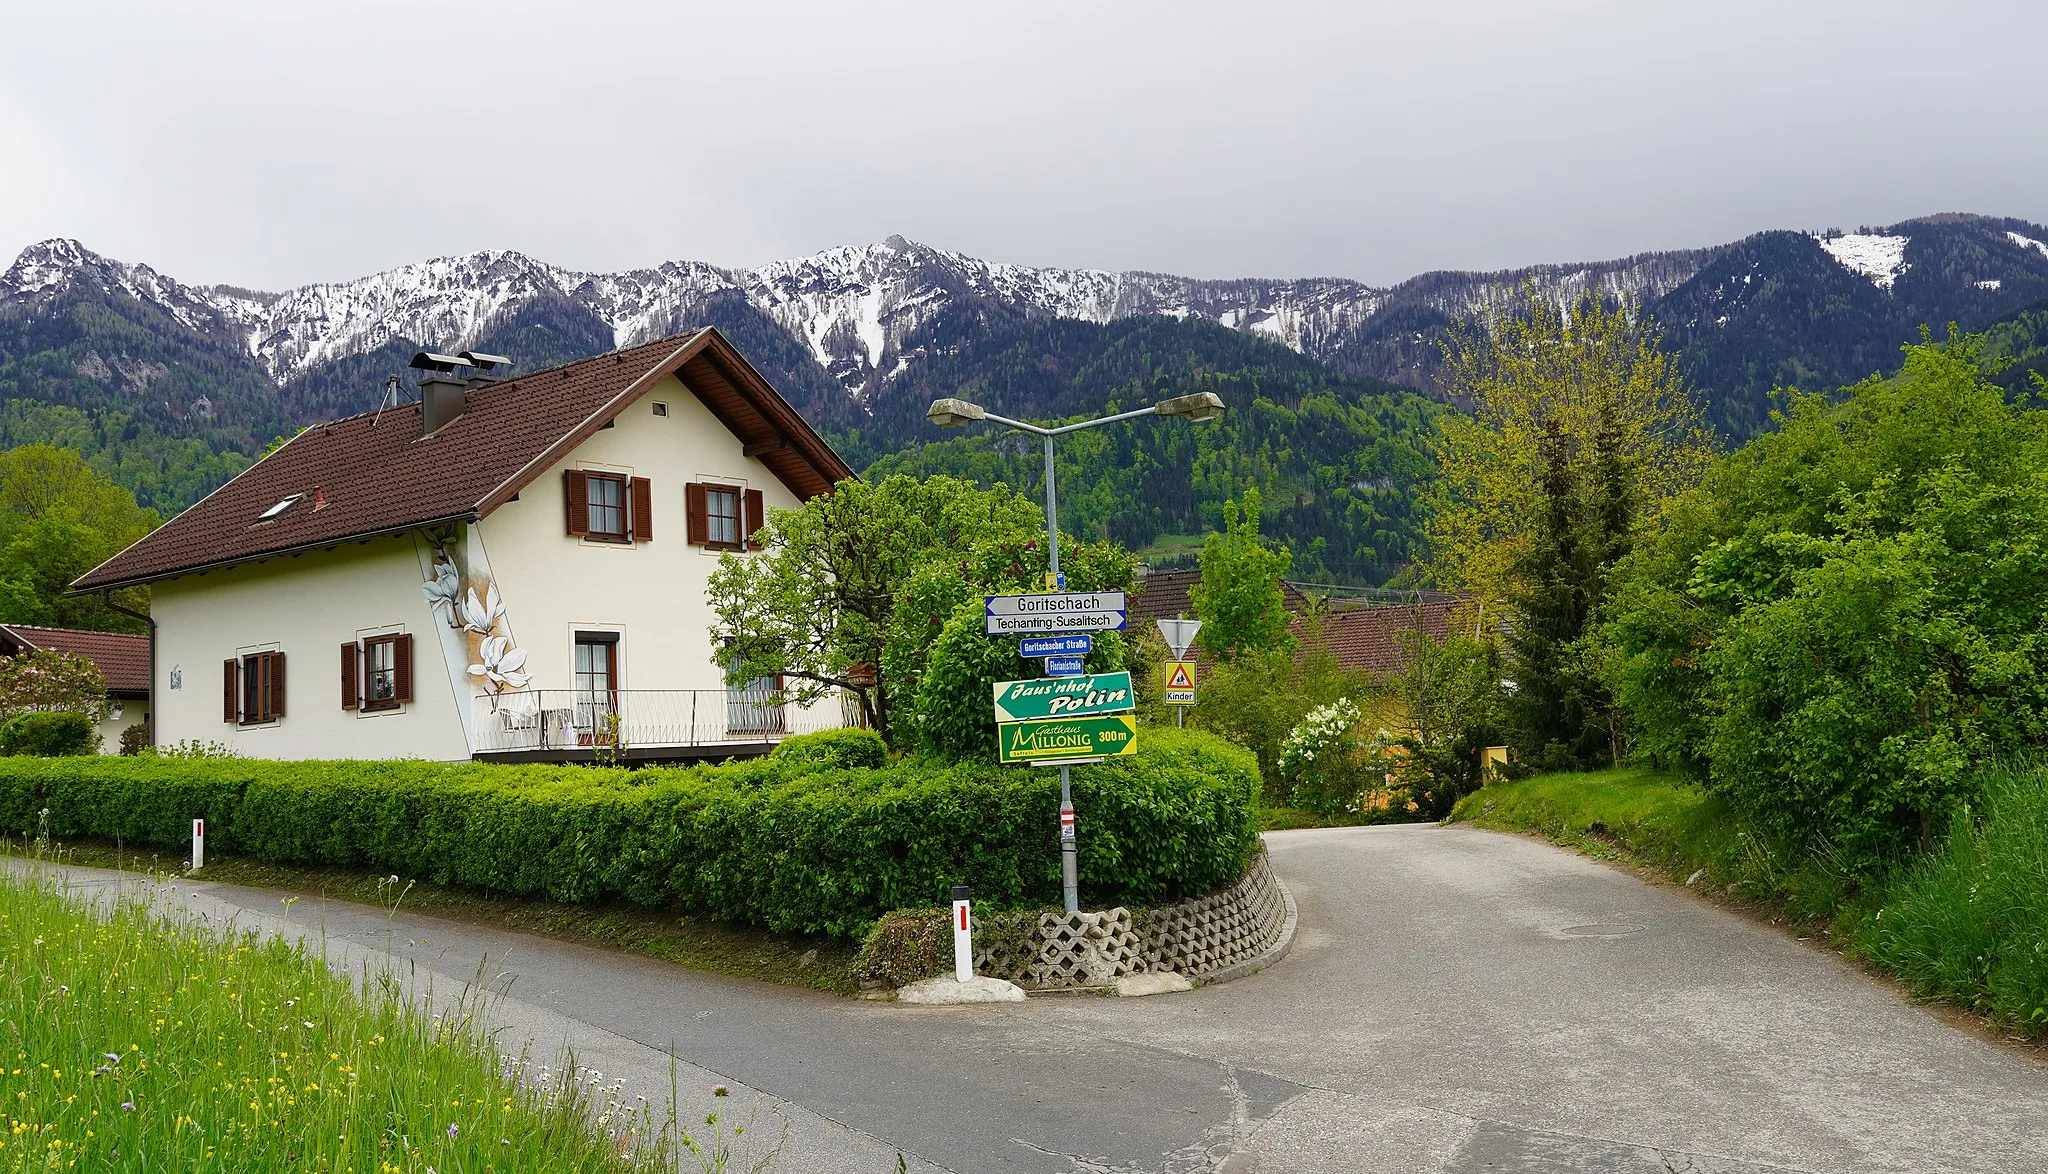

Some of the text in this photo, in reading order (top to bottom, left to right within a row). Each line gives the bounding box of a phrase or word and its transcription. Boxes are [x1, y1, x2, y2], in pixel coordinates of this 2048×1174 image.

[1018, 595, 1099, 611] Goritschach
[996, 614, 1110, 630] Techanting-Susalitsch
[1024, 640, 1087, 652] Goritschacher Straße
[1050, 660, 1081, 671] Florianistraße
[1011, 678, 1095, 700] Jaus'nhof
[1167, 692, 1193, 701] Kinder
[1048, 688, 1127, 714] Polin
[1036, 724, 1081, 736] Gasthaus
[1011, 727, 1091, 753] MILLONIG
